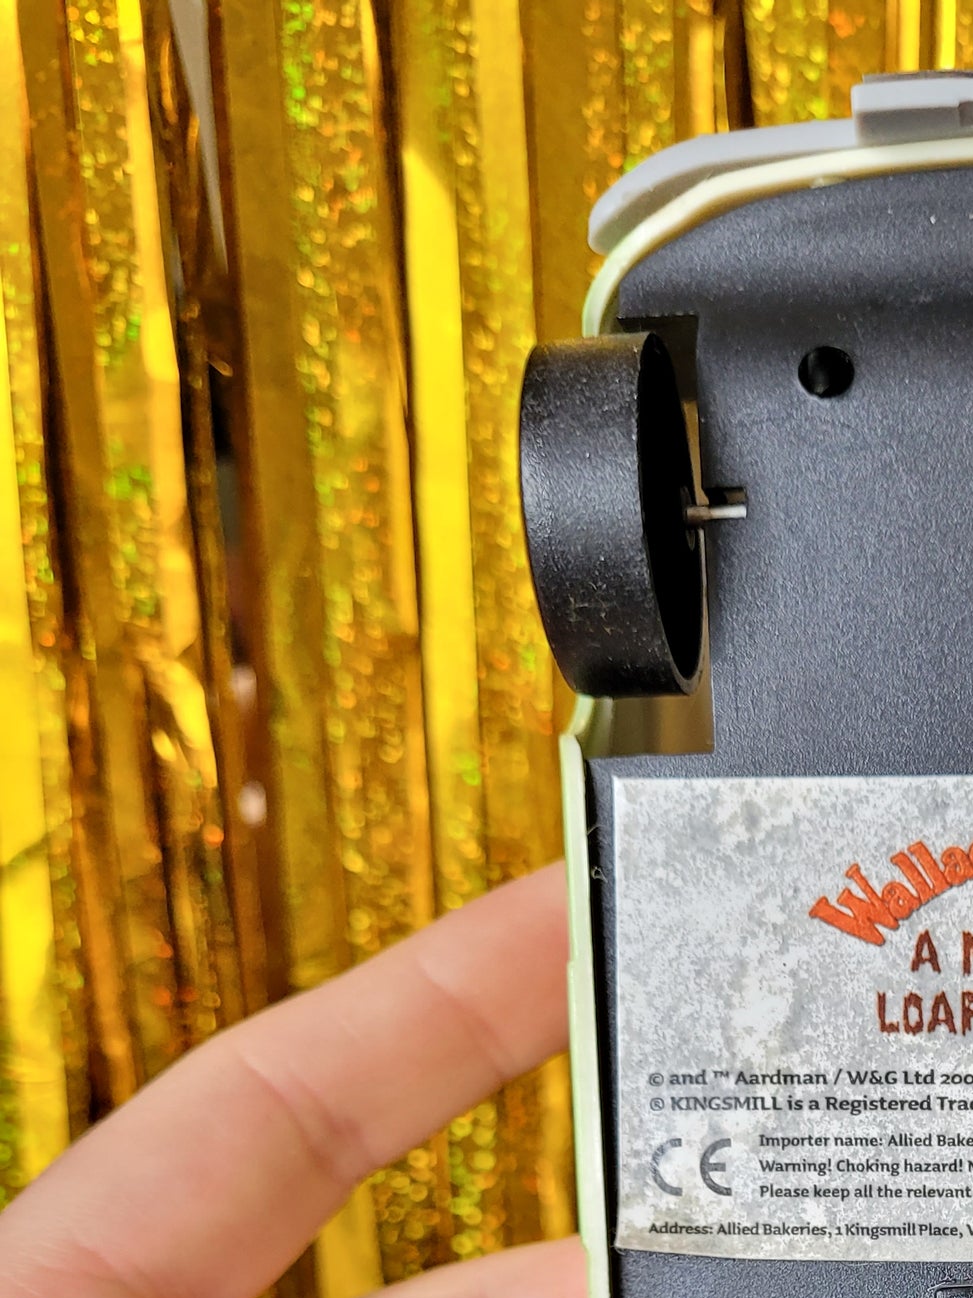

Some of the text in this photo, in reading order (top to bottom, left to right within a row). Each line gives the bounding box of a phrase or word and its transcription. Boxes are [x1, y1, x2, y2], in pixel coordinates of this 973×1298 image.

[910, 929, 942, 974] A
[669, 1070, 707, 1086] and
[734, 1070, 827, 1086] Aardman
[847, 1070, 898, 1086] W&G
[903, 1070, 935, 1086] Ltd
[670, 1096, 783, 1112] KINGSMILL
[787, 1096, 803, 1111] is
[808, 1100, 820, 1111] a
[825, 1096, 931, 1116] Registered
[759, 1134, 829, 1151] Importer
[834, 1136, 884, 1147] name:
[887, 1134, 932, 1148] Allied
[759, 1160, 832, 1176] Warning!
[836, 1160, 900, 1176] Choking
[904, 1160, 963, 1173] hazard!
[760, 1185, 810, 1199] Please
[814, 1185, 850, 1201] keep
[854, 1185, 873, 1198] all
[877, 1185, 903, 1198] the
[907, 1185, 971, 1198] relevant
[649, 1222, 713, 1235] Address:
[717, 1222, 759, 1236] Allied
[763, 1222, 833, 1238] Bakeries,
[835, 1227, 842, 1236] 1
[845, 1222, 917, 1240] Kingsmill
[918, 1224, 963, 1238] Place,
